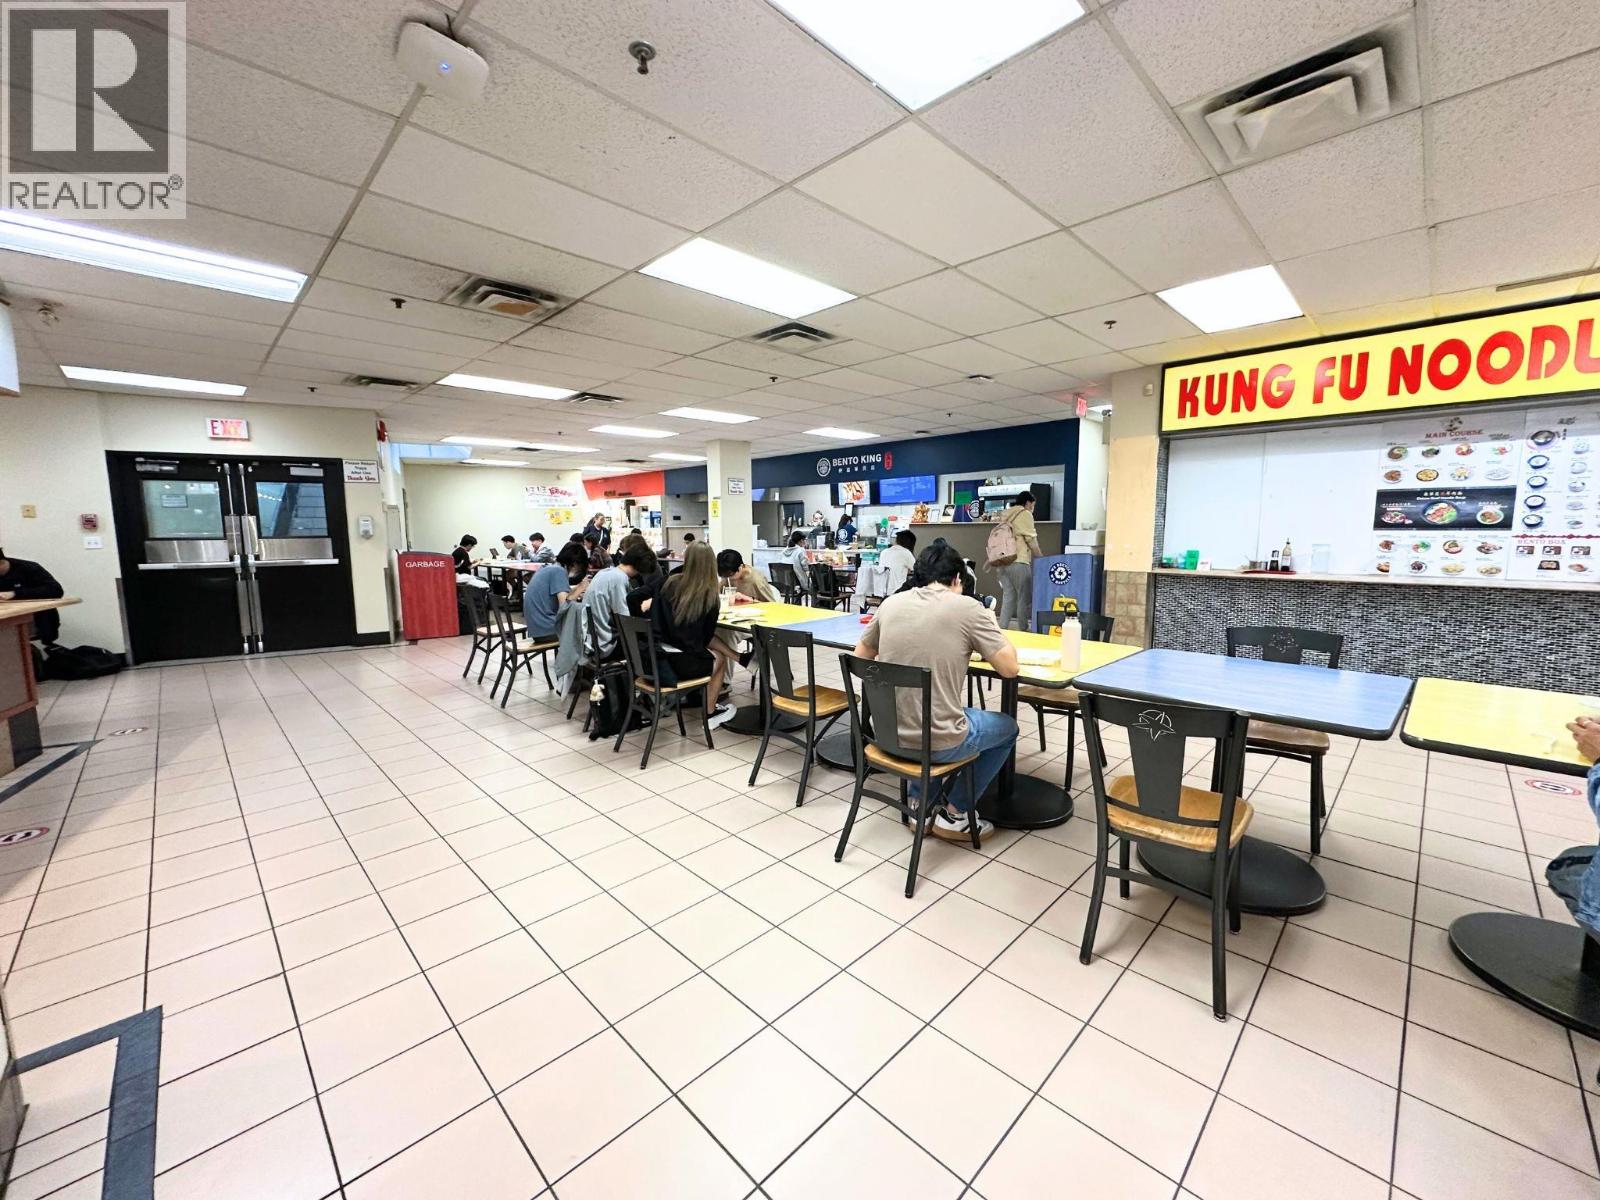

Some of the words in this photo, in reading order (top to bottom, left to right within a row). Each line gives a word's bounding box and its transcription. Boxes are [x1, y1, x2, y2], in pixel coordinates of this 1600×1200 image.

[1177, 363, 1296, 420] KUNG
[1312, 351, 1370, 405] FU
[1387, 317, 1600, 396] NOODL
[1449, 429, 1484, 437] COURSE
[832, 456, 859, 467] BENTO
[860, 453, 882, 464] KING
[405, 560, 446, 568] GARBAGE
